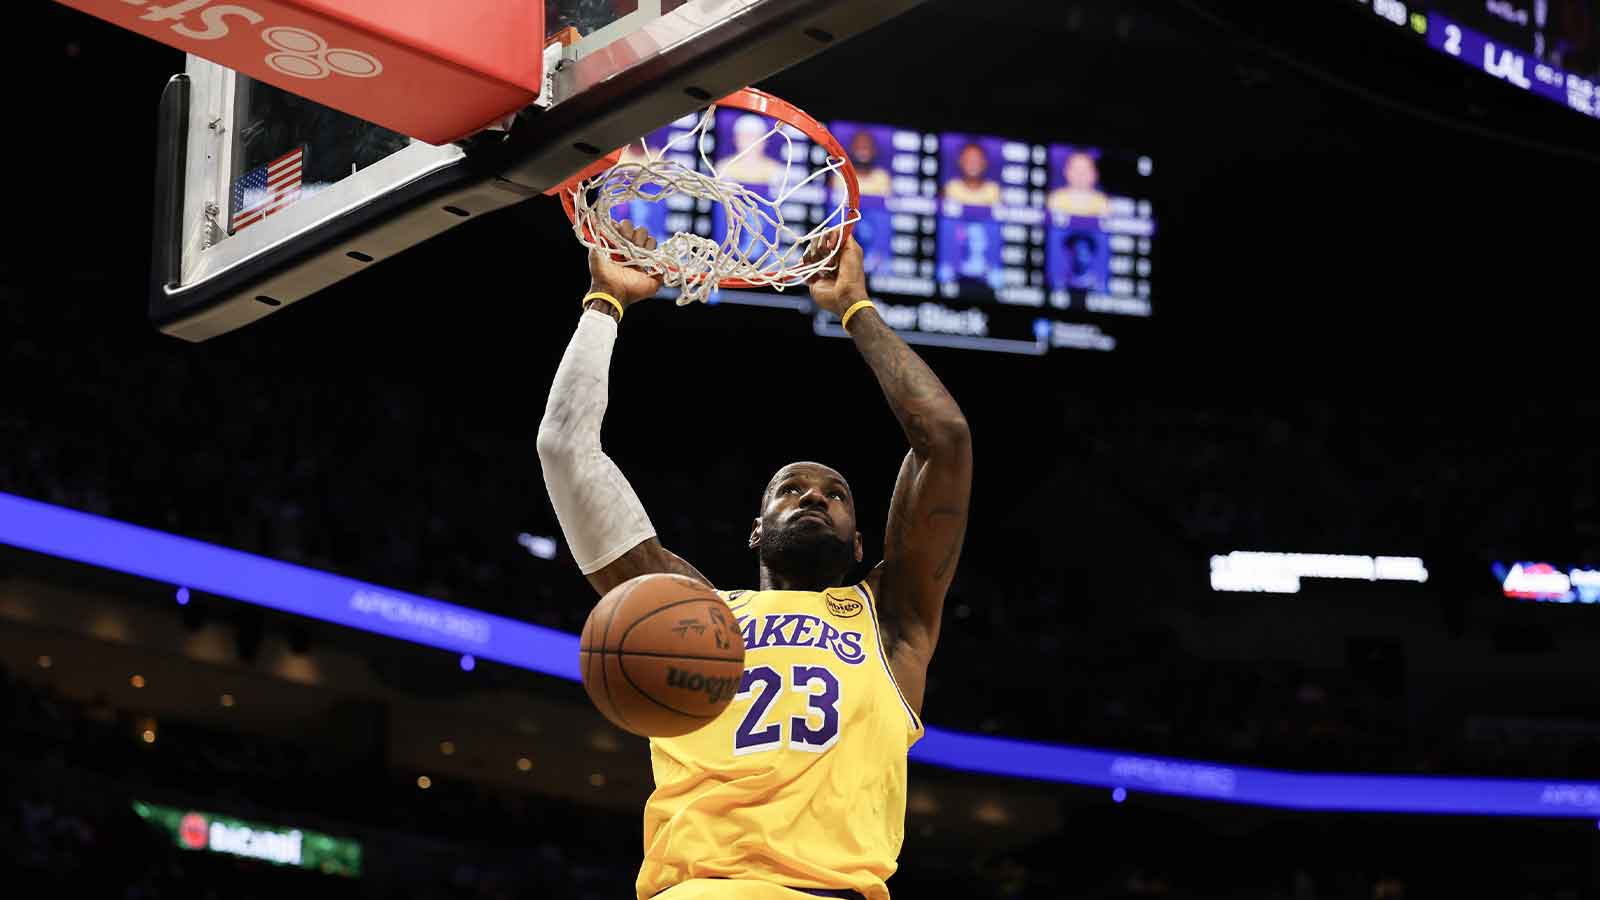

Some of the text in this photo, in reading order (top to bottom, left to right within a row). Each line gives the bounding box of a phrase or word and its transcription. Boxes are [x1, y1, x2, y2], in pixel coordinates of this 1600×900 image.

[120, 0, 264, 40] St
[1484, 42, 1532, 89] LAL
[736, 614, 866, 665] AKERS
[733, 664, 840, 755] 23
